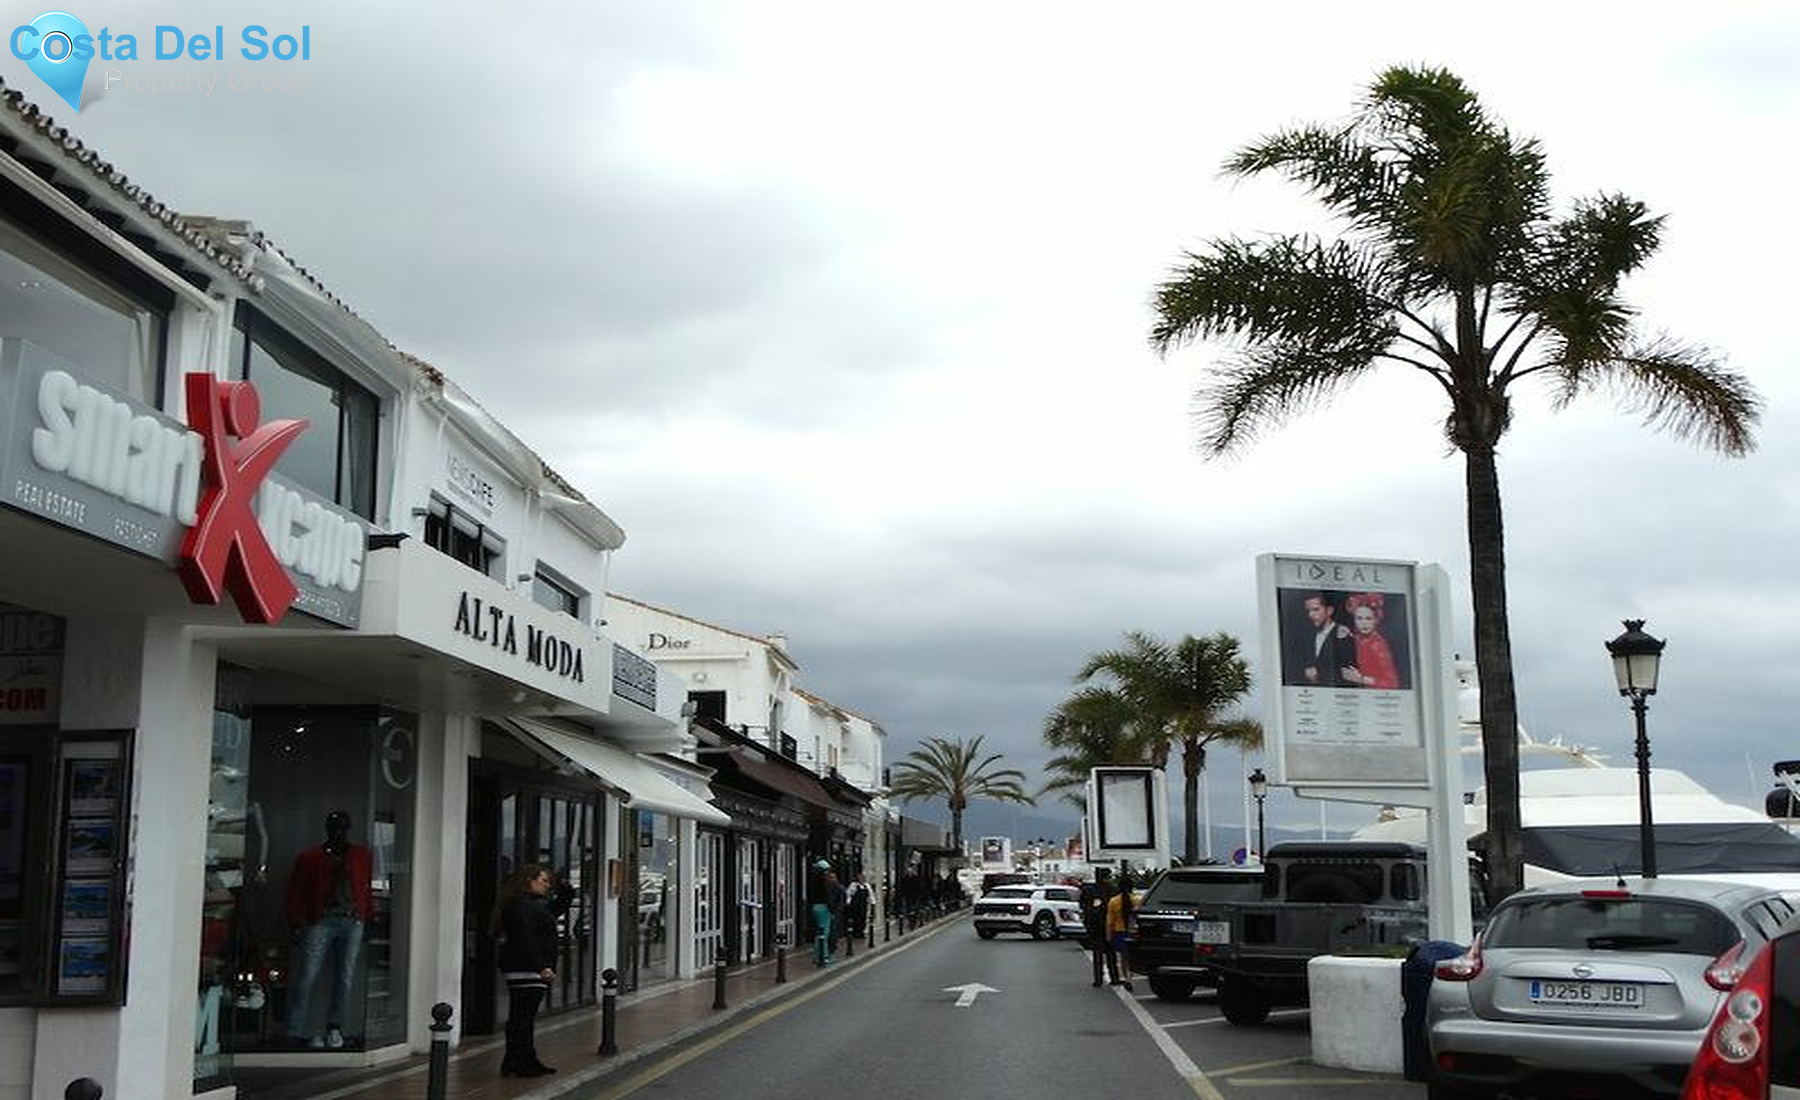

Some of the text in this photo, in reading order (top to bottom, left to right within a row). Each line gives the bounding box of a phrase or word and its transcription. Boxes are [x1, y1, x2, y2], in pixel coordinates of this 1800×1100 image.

[15, 480, 86, 524] REAL ESTATE
[1297, 564, 1383, 583] IDEAL
[454, 591, 518, 655] ALTA
[526, 624, 584, 683] MODA
[648, 633, 691, 651] Dior
[1544, 983, 1637, 1002] 0256 JBD
